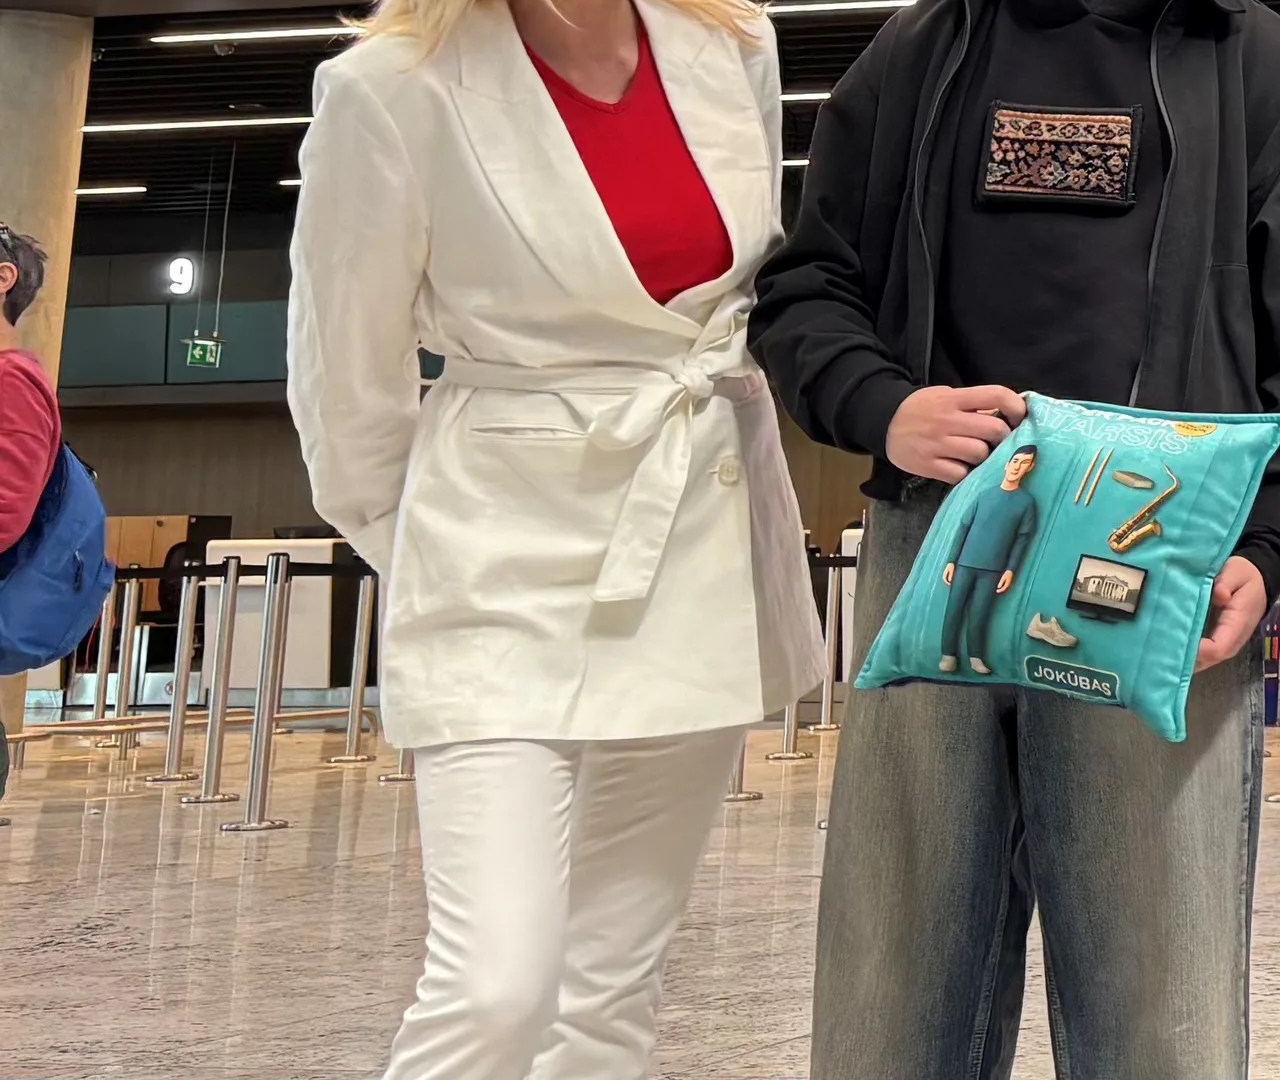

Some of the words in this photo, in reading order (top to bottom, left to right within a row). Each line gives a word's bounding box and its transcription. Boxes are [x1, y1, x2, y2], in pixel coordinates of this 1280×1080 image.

[169, 257, 195, 295] 9
[1030, 402, 1189, 455] ATARSIS
[1033, 664, 1112, 698] JOKŪBAS
